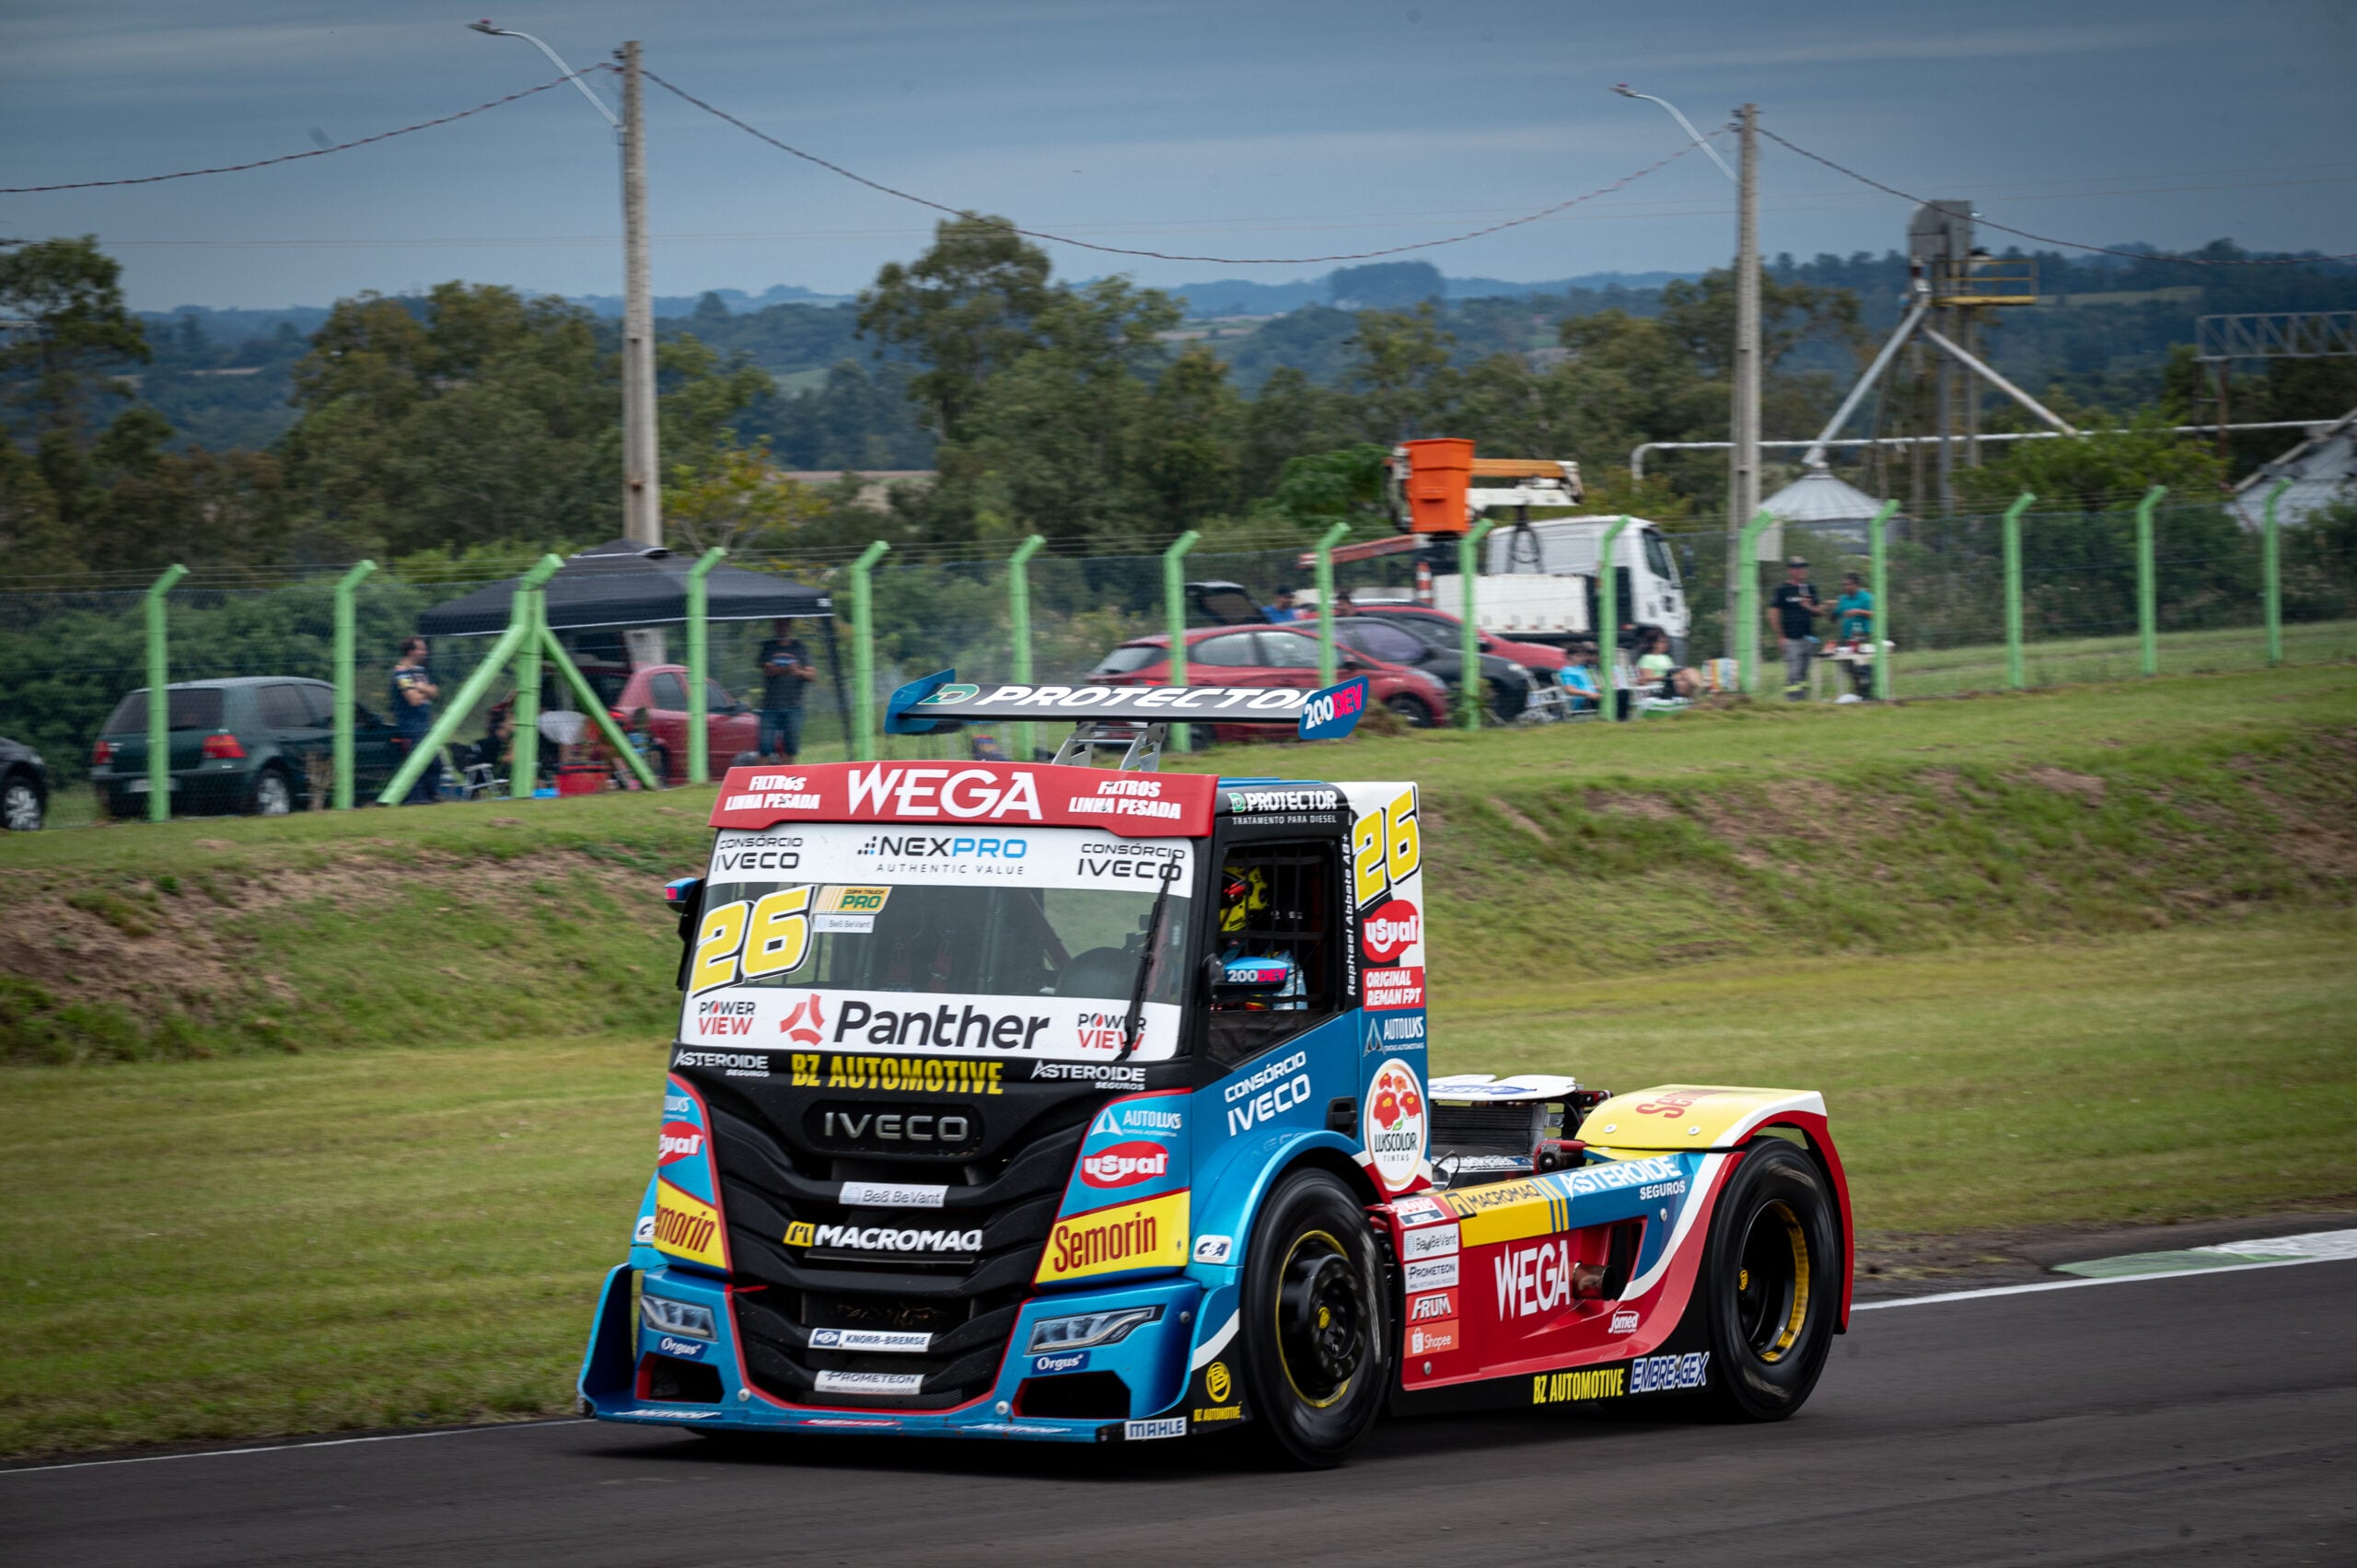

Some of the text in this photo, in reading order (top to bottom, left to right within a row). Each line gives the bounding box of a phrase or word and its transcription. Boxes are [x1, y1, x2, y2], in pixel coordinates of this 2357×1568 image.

[1304, 683, 1363, 729] 200DEV
[749, 775, 807, 792] FILTROS
[848, 762, 1043, 820] WEGA
[1097, 780, 1162, 797] FILTROS
[724, 794, 821, 811] LINHA PESADA
[1068, 797, 1181, 819] LINHA PESADA
[1245, 790, 1338, 812] PROTECTOR
[1232, 814, 1337, 825] TRATAMENTO PARA DIESEL
[718, 834, 804, 850] CONSÓRCIO
[878, 836, 1028, 858] NEXPRO
[1081, 842, 1186, 860] CONSÓRCIO
[1352, 785, 1421, 911] 26
[714, 852, 800, 873] IVECO
[876, 863, 1025, 876] AUTHENTIC VALUE
[1077, 858, 1183, 882] IVECO
[839, 895, 882, 909] PRO
[1344, 868, 1353, 925] Abbate
[690, 884, 816, 999] 26
[1345, 928, 1356, 996] Raphael
[1226, 969, 1288, 983] 200DEV
[1365, 970, 1412, 988] ORIGINAL
[1366, 987, 1422, 1006] REMAN FPT
[698, 1016, 753, 1035] VIEW
[832, 1000, 1051, 1050] Panther
[1077, 1012, 1146, 1031] POWR
[1383, 1016, 1425, 1040] AUTOLUKS
[673, 1048, 770, 1070] ASTEROIDE
[725, 1068, 771, 1077] SEGUROS
[791, 1053, 1004, 1096] BZ AUTOMOTIVE
[1030, 1059, 1146, 1082] ASTEROIDE
[1224, 1050, 1307, 1103] CONSÓRCIO
[1094, 1081, 1145, 1091] SEGUROS
[1226, 1073, 1311, 1137] IVECO
[824, 1111, 969, 1142] IVECO
[1122, 1109, 1183, 1130] AUTOLUKS
[1383, 1155, 1411, 1163] TINTAS
[1557, 1155, 1683, 1202] ASTEROIDE
[892, 1191, 942, 1205] BeVant
[1468, 1184, 1542, 1211] MACROMAQ
[1639, 1179, 1686, 1201] SEGUROS
[814, 1225, 983, 1252] MACROMAQ
[1053, 1211, 1157, 1273] Semorin
[1408, 1262, 1457, 1280] PROMETEON
[1493, 1239, 1571, 1322] WEGA
[1411, 1293, 1452, 1321] FRUM
[660, 1336, 702, 1355] Orgus
[844, 1333, 928, 1346] KNORR-BREMSE
[1424, 1333, 1452, 1352] Shopee
[1036, 1353, 1084, 1371] Orgus
[1532, 1367, 1625, 1405] BZ AUTOMOTIVE
[1128, 1420, 1186, 1438] MAHLE
